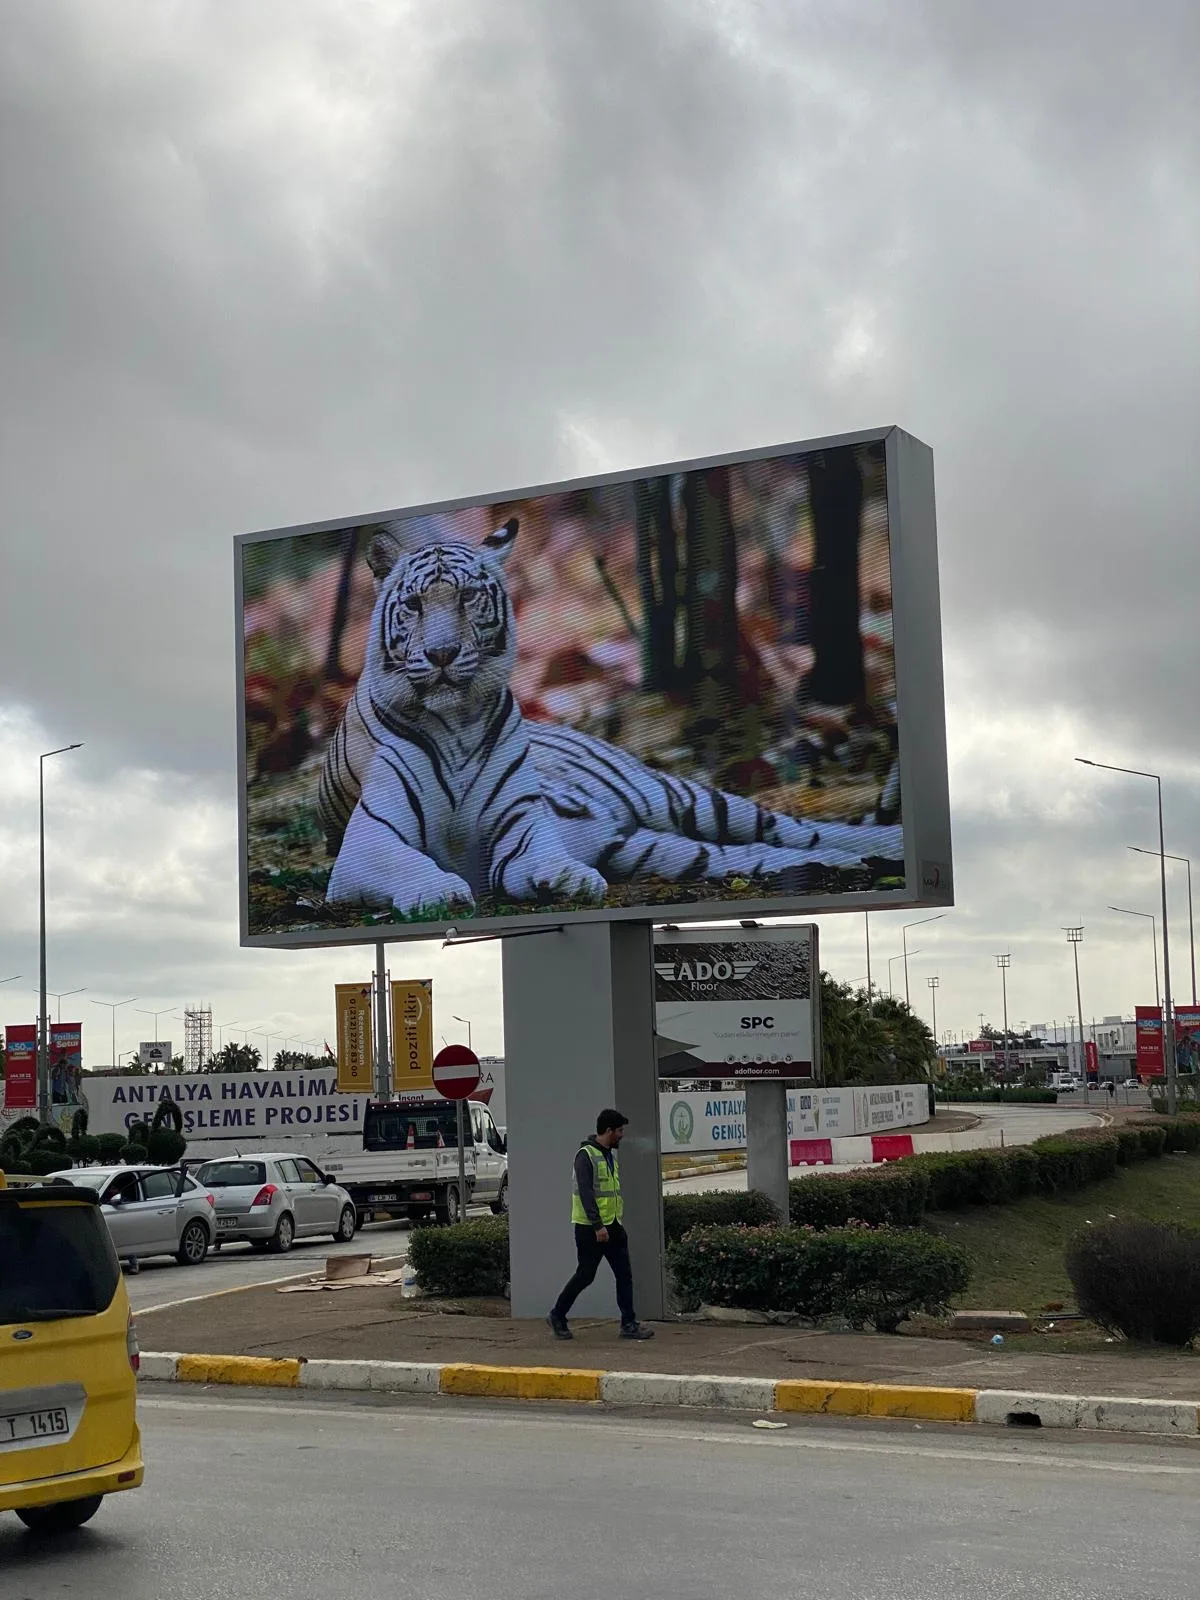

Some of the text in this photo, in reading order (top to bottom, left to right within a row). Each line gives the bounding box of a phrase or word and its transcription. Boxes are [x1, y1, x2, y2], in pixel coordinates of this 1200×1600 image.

[677, 961, 733, 981] ADO
[691, 982, 718, 991] Floor
[404, 993, 421, 1070] pozitifikir
[740, 1016, 775, 1029] SPC
[734, 1067, 780, 1075] adofloor.com
[112, 1083, 213, 1103] ANTALYA
[265, 1099, 359, 1125] PROJESİ
[7, 1411, 65, 1437] T 1415
